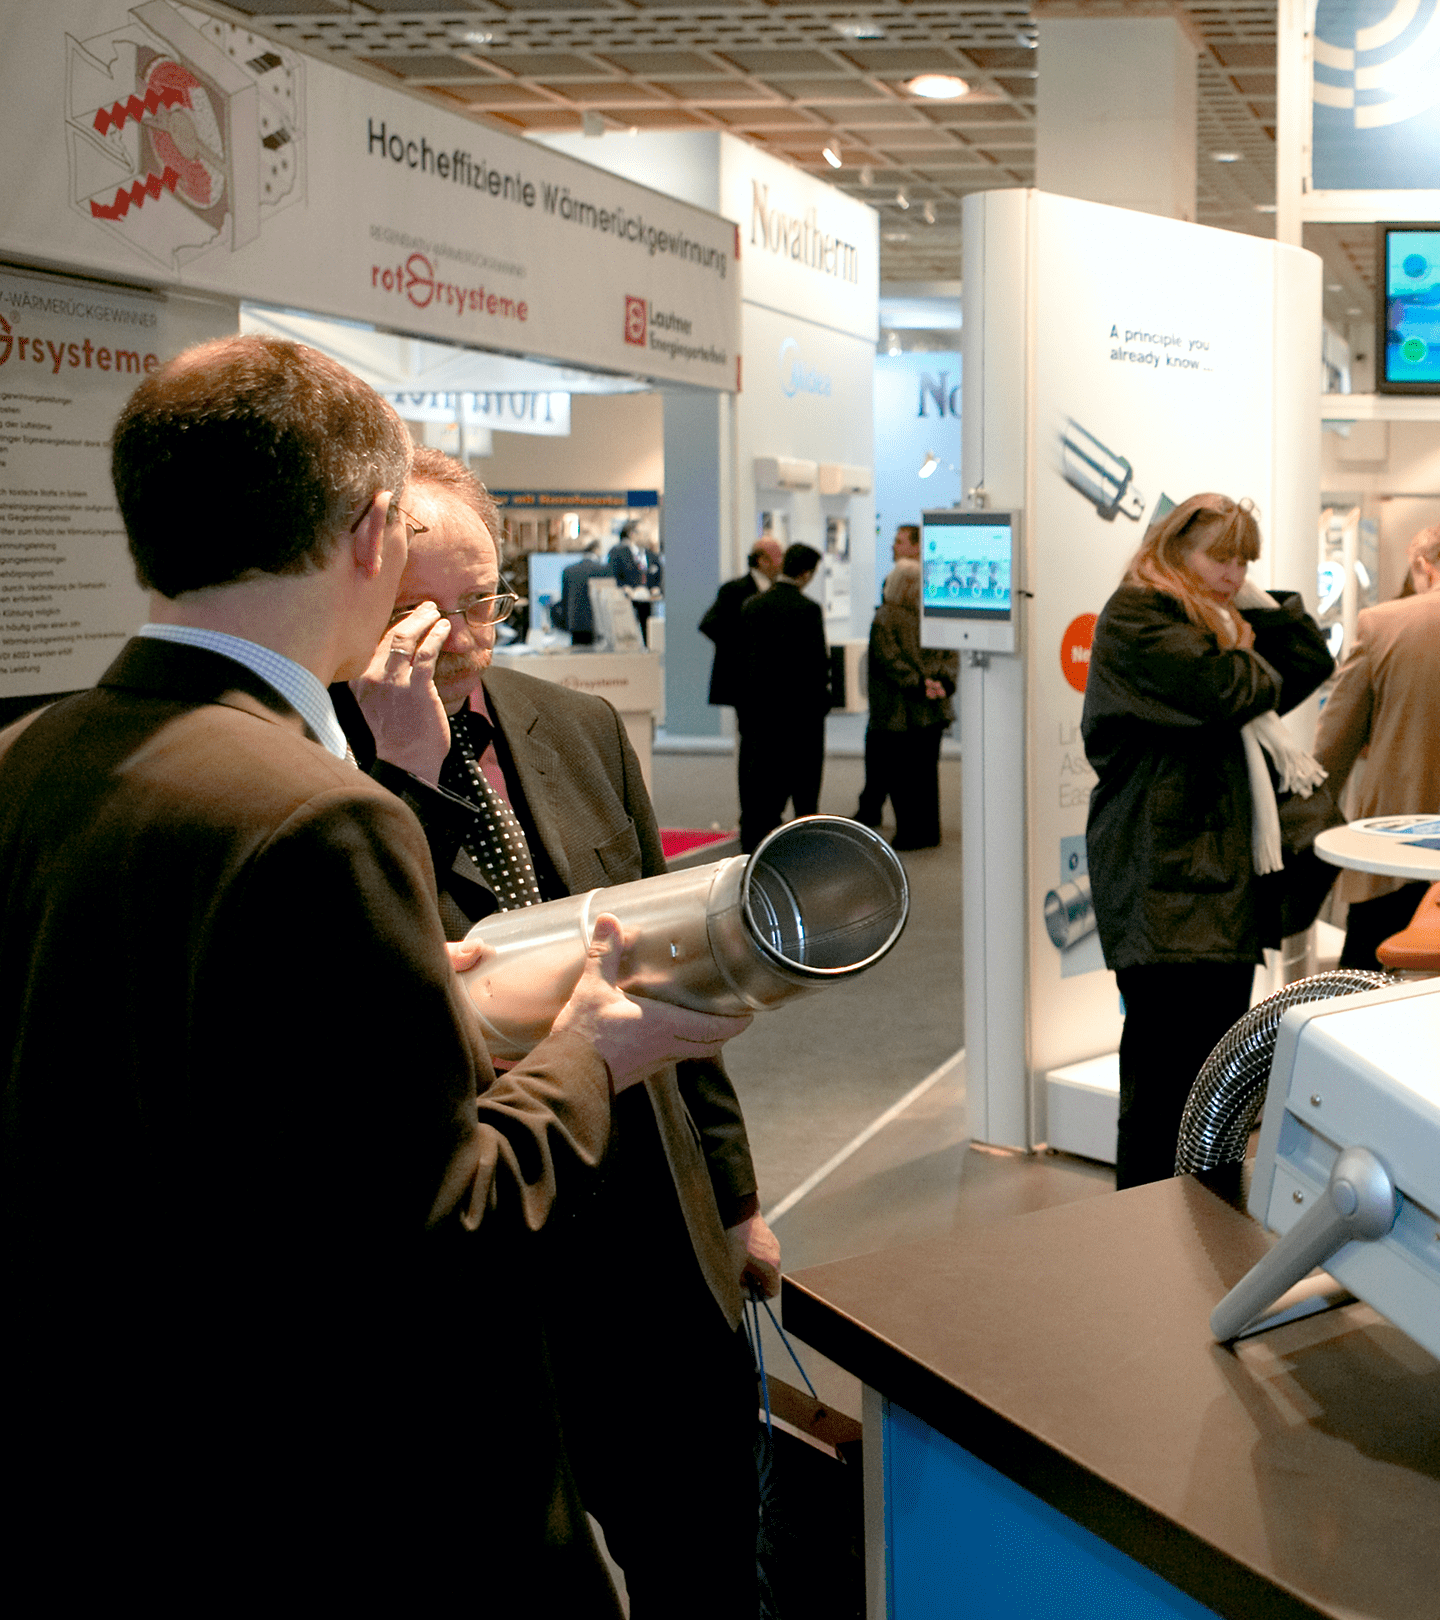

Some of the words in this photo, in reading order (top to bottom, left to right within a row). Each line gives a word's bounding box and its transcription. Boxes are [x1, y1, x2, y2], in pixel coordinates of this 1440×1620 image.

[368, 117, 537, 209] Hocheffiziente
[541, 180, 728, 280] Wärmerückgewinnung
[751, 178, 858, 285] Novatherm
[1109, 324, 1119, 339] A
[1125, 328, 1182, 348] principle
[1189, 339, 1210, 352] you
[1110, 346, 1160, 369] already
[1166, 353, 1200, 370] know
